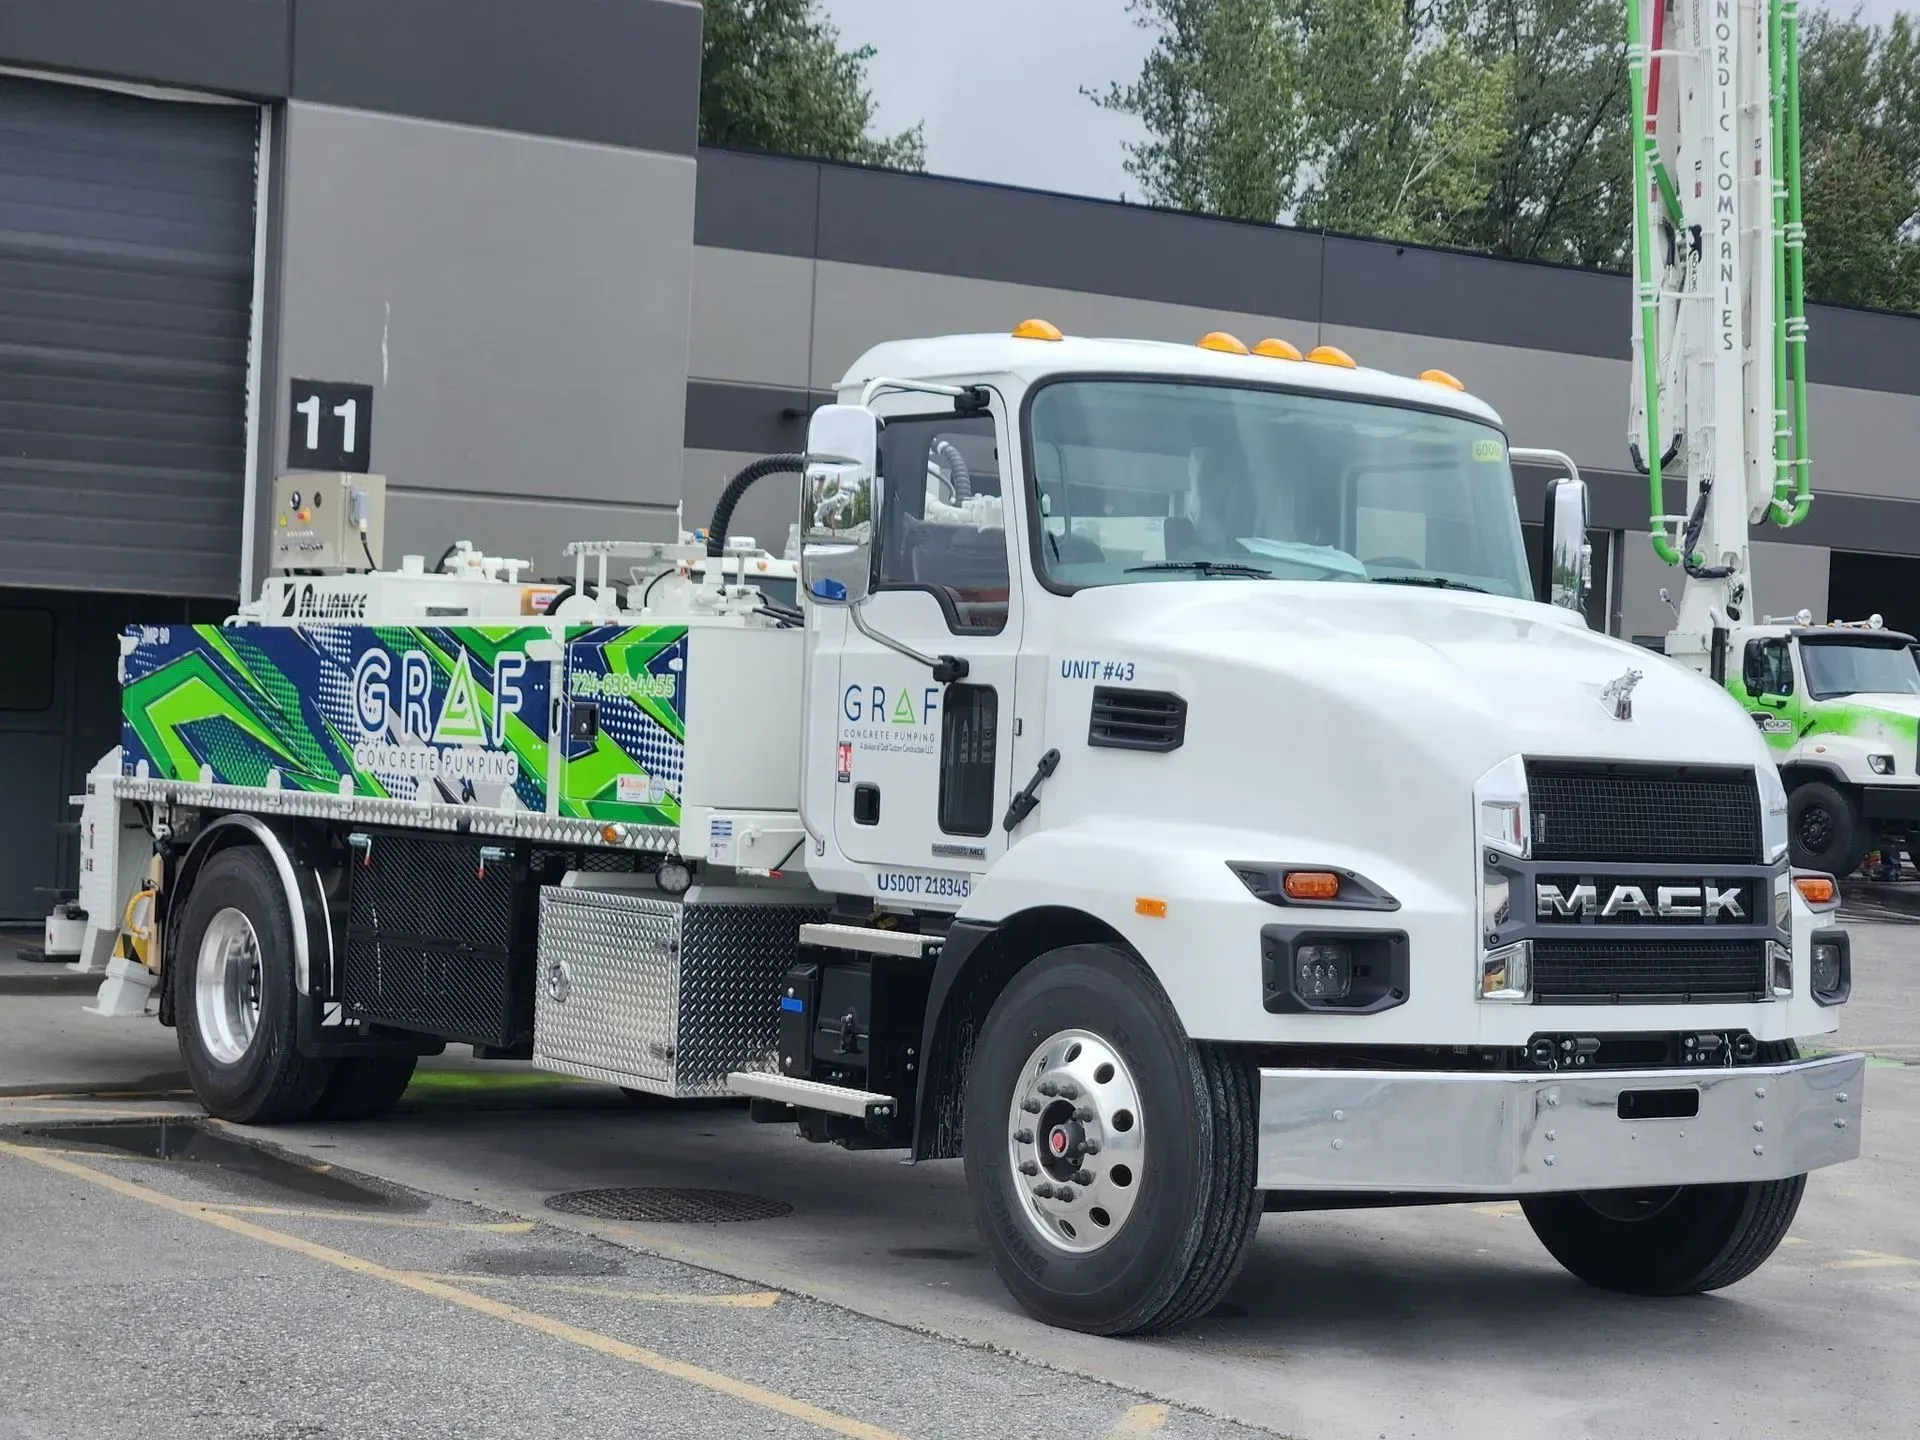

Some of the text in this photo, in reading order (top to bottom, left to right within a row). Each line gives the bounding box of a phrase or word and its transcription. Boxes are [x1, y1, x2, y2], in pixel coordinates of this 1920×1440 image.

[1715, 0, 1734, 350] NORDIC COMPANIES
[296, 395, 357, 453] 11
[299, 583, 367, 619] ALLIANCE
[571, 673, 676, 697] 724-638-4455
[1061, 659, 1135, 681] UNIT #43
[354, 644, 526, 747] GRAF
[844, 684, 939, 725] GRAF
[843, 728, 935, 742] CONCRETE PUMPING
[355, 749, 516, 777] CONCRETE PUMPING
[878, 873, 972, 898] USDOT 218345
[1536, 884, 1746, 918] MACK
